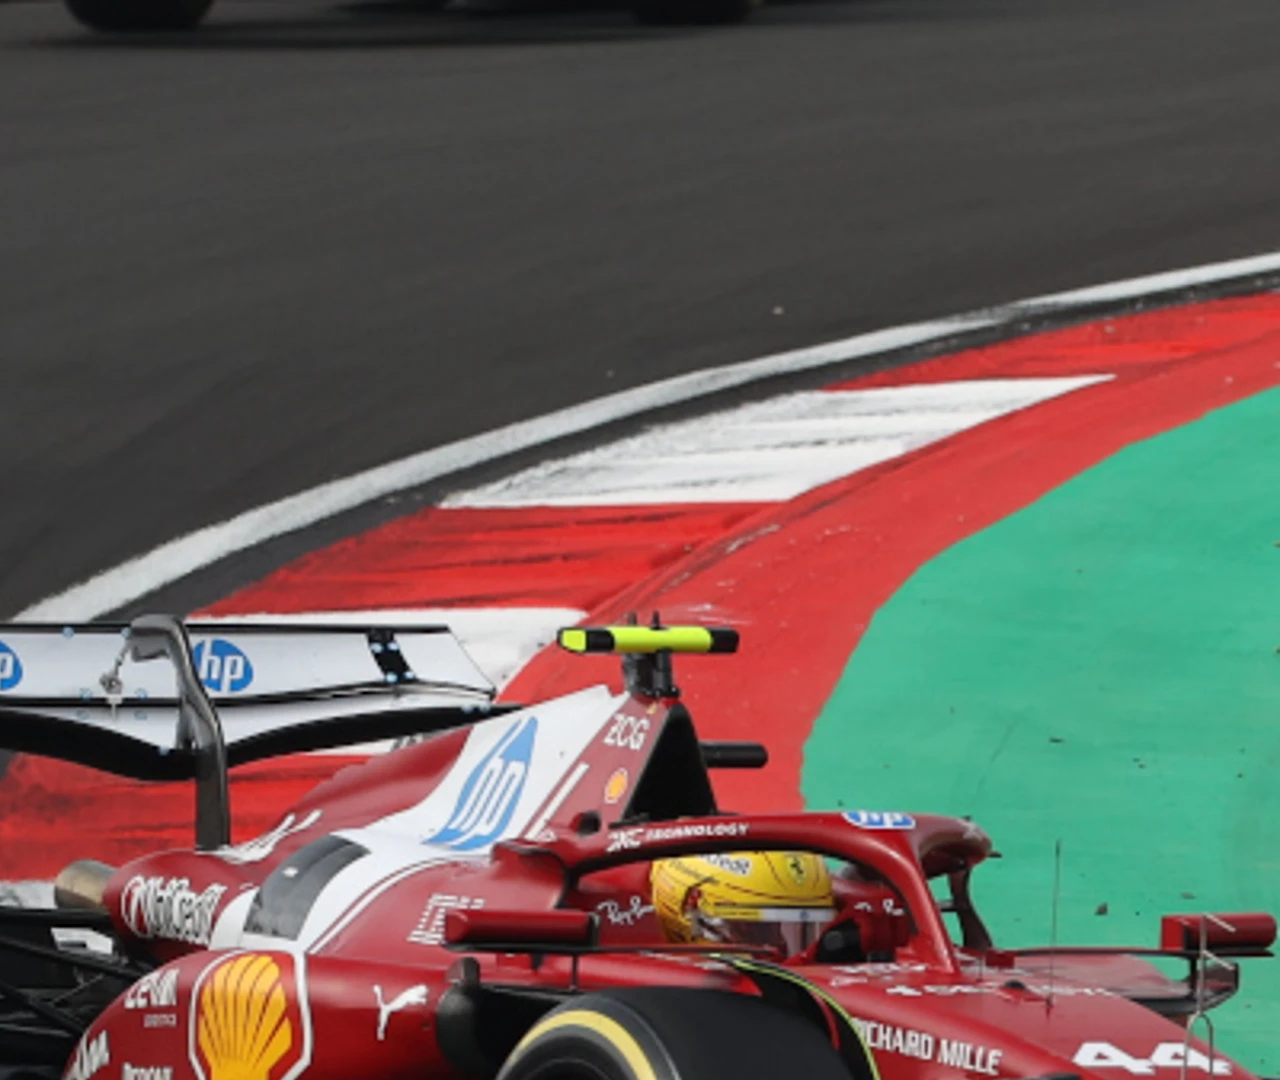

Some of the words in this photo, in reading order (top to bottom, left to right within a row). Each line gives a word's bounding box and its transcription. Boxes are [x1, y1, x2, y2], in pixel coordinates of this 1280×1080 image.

[200, 640, 244, 691] hp
[440, 716, 530, 848] hp
[937, 1039, 1003, 1076] MILLE
[1073, 1041, 1232, 1076] 44
